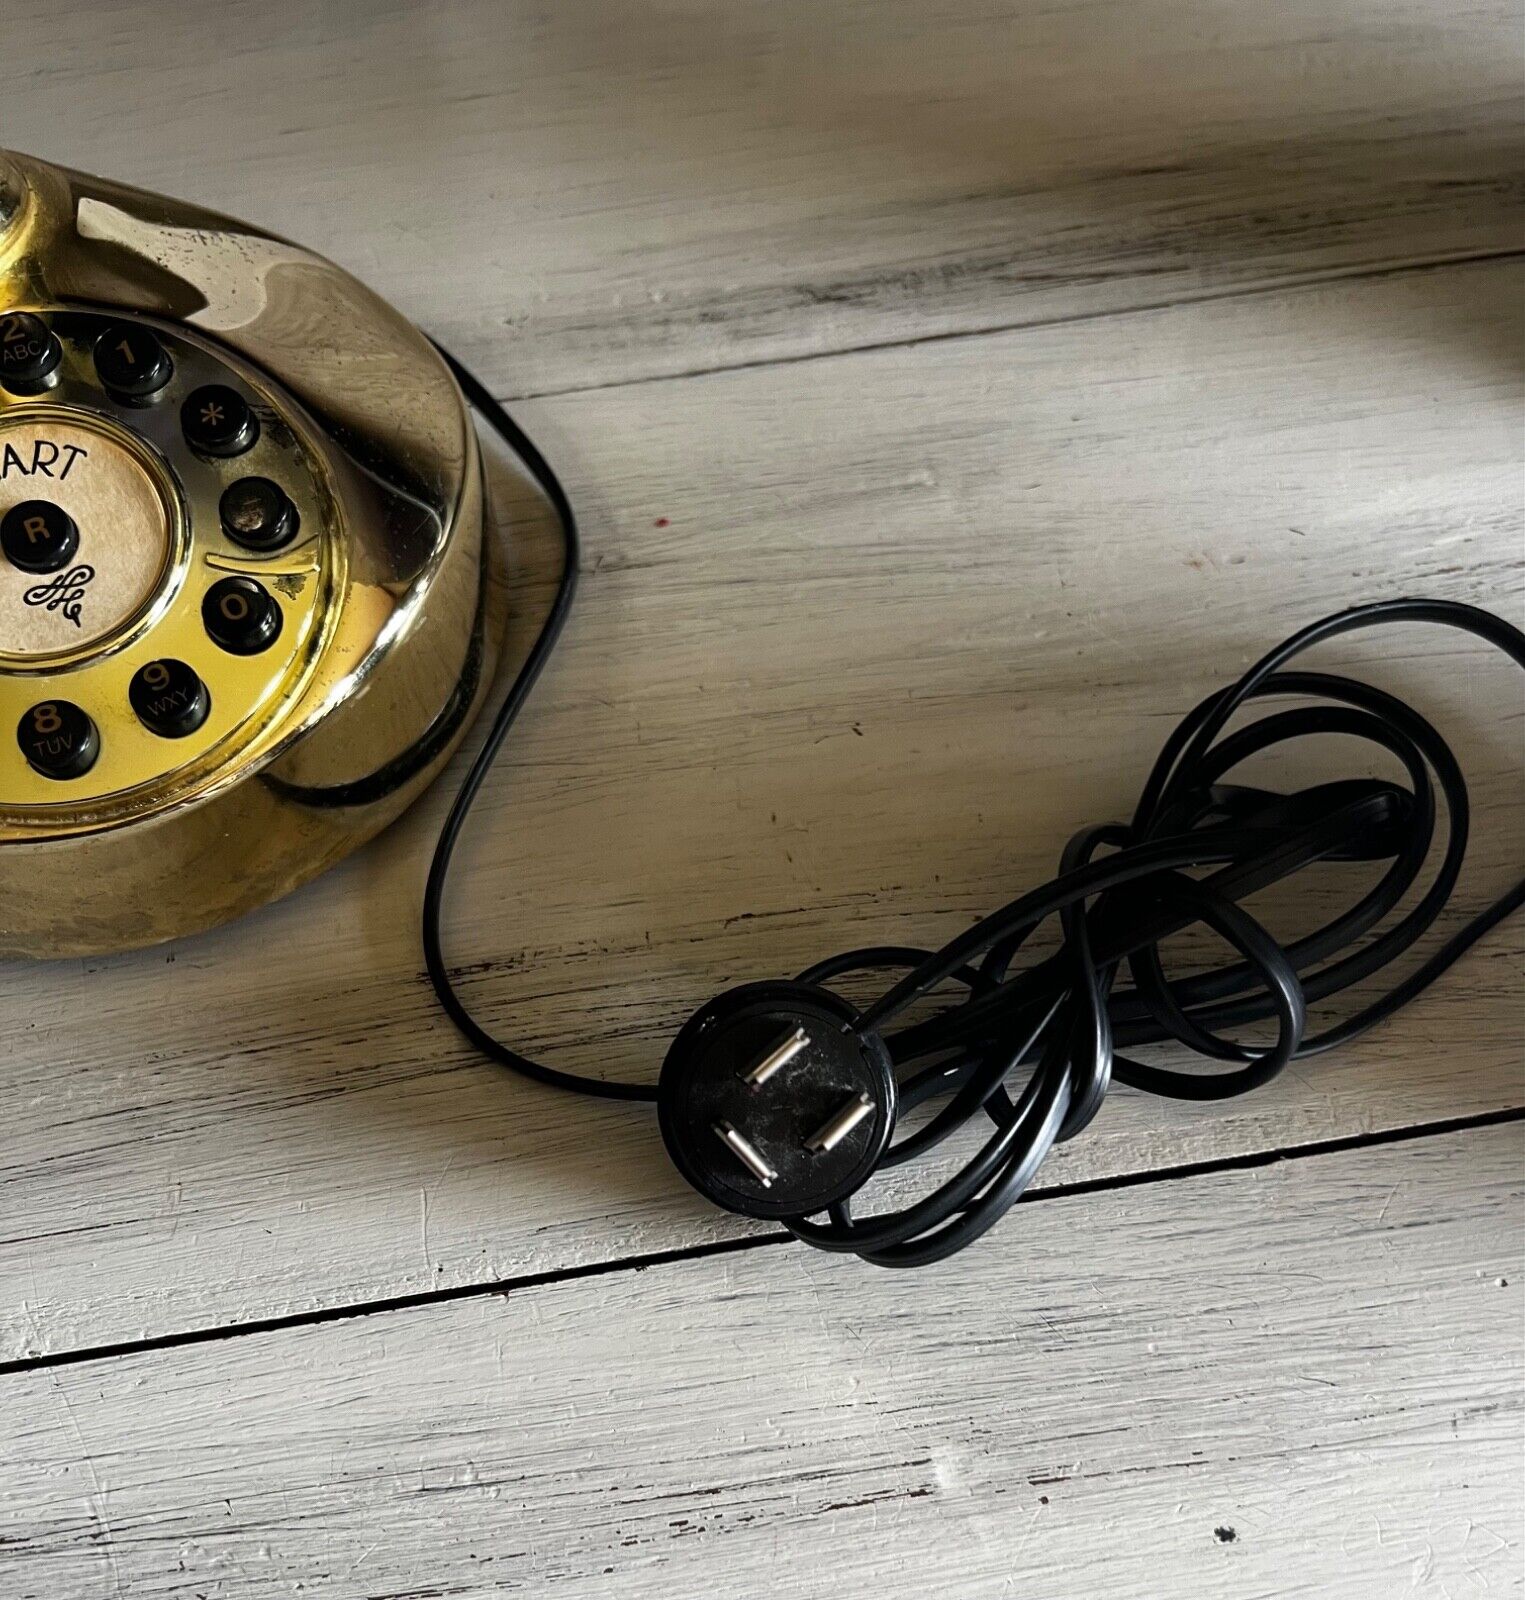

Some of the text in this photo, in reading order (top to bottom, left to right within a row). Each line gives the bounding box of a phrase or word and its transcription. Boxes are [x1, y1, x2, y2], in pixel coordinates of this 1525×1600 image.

[2, 315, 25, 343] 2
[3, 340, 41, 364] ABC
[115, 340, 136, 364] 1
[0, 440, 88, 480] ART
[23, 516, 50, 543] R
[143, 663, 170, 691] 9
[146, 687, 189, 716] WXY
[33, 704, 62, 733] 8
[33, 733, 73, 757] TUV
